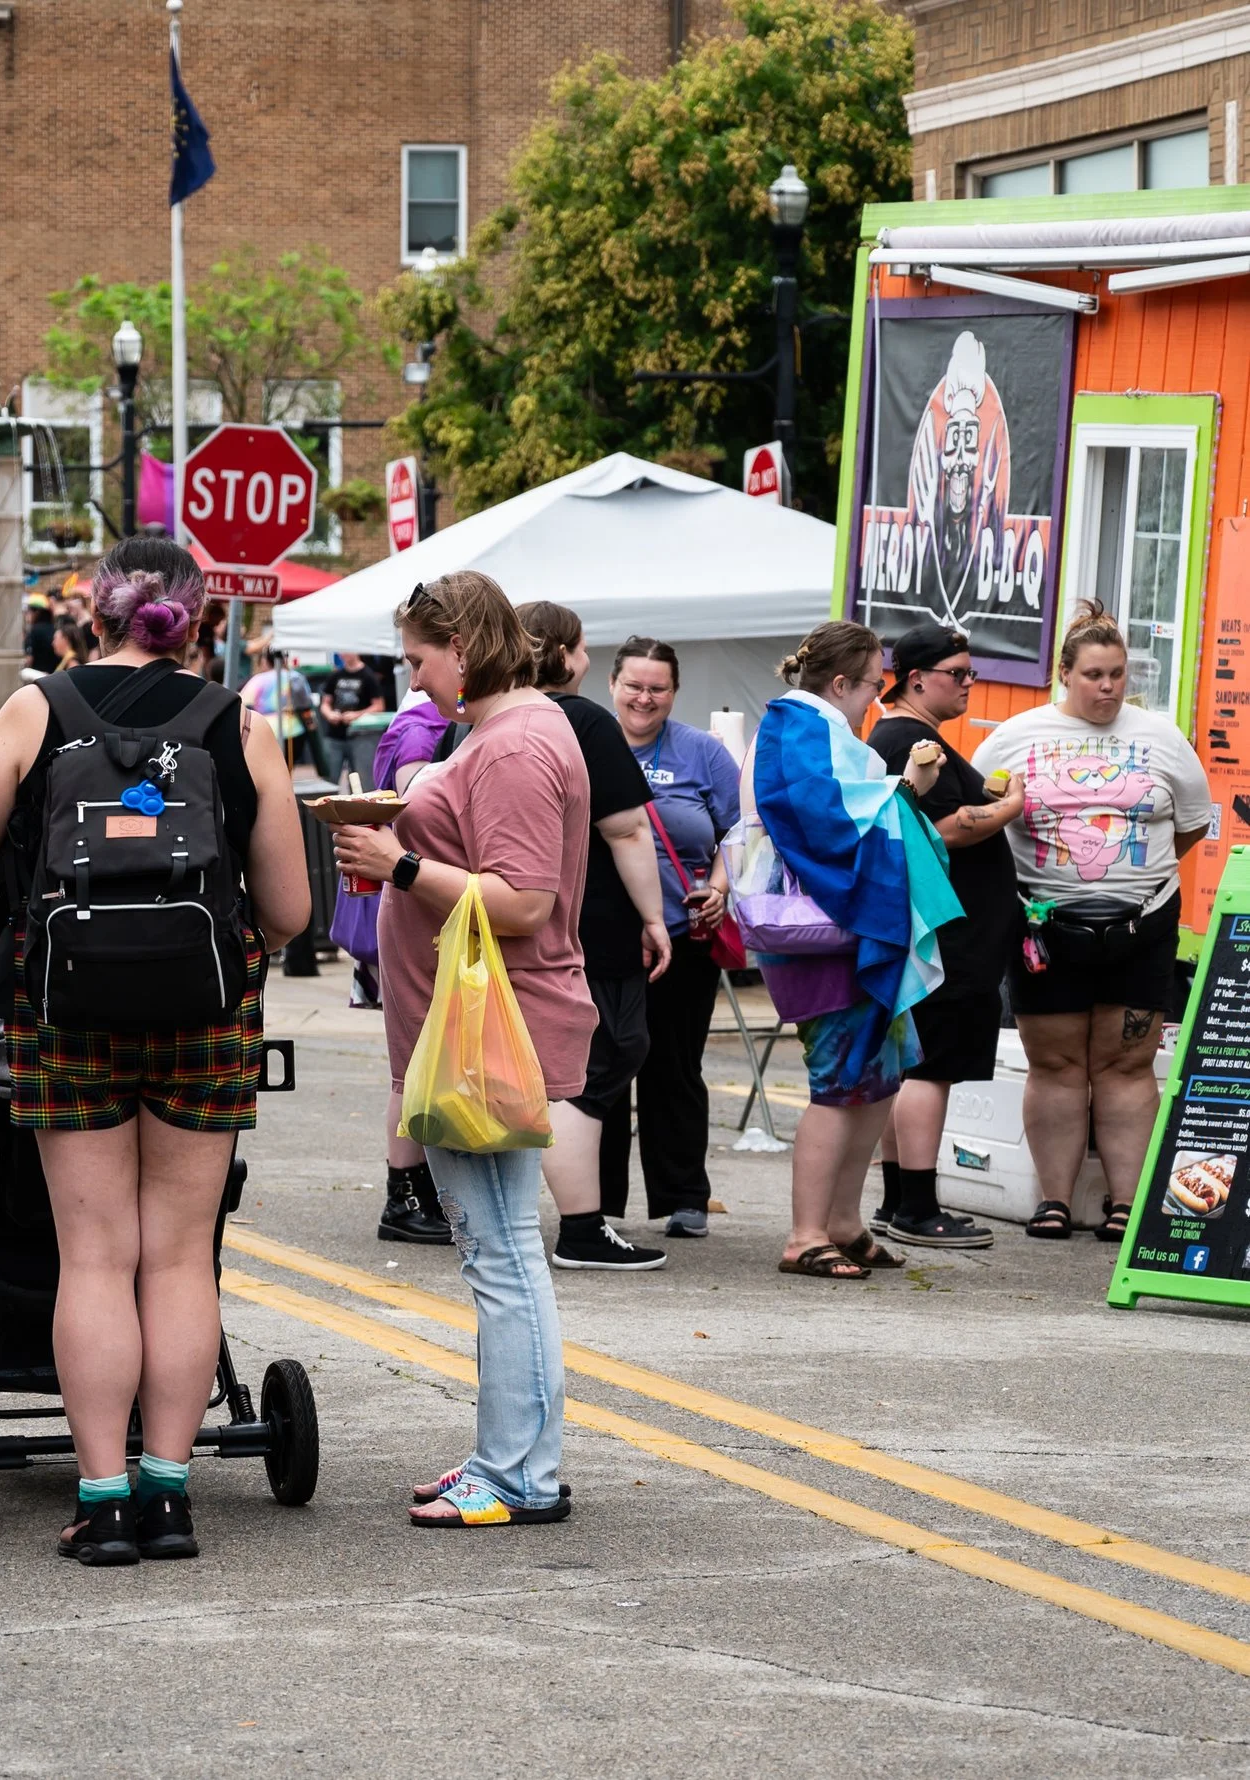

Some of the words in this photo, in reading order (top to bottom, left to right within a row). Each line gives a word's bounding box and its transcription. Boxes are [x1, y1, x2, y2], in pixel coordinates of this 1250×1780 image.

[188, 466, 307, 526] STOP
[861, 521, 931, 595] NERDY
[977, 526, 1043, 610] B-B-Q
[205, 573, 235, 593] ALL
[242, 576, 276, 595] WAY
[1223, 1047, 1236, 1056] FOOT
[1191, 1081, 1228, 1096] Signature
[1185, 1105, 1206, 1115] Spanish
[1178, 1129, 1195, 1137] Indian
[1170, 1218, 1184, 1227] Don't
[1183, 1219, 1199, 1230] forget
[1200, 1221, 1206, 1229] to
[1170, 1228, 1181, 1239] ADD
[1183, 1230, 1201, 1240] ONION
[1137, 1246, 1157, 1261] Find
[1156, 1252, 1167, 1262] us
[1168, 1253, 1180, 1263] on
